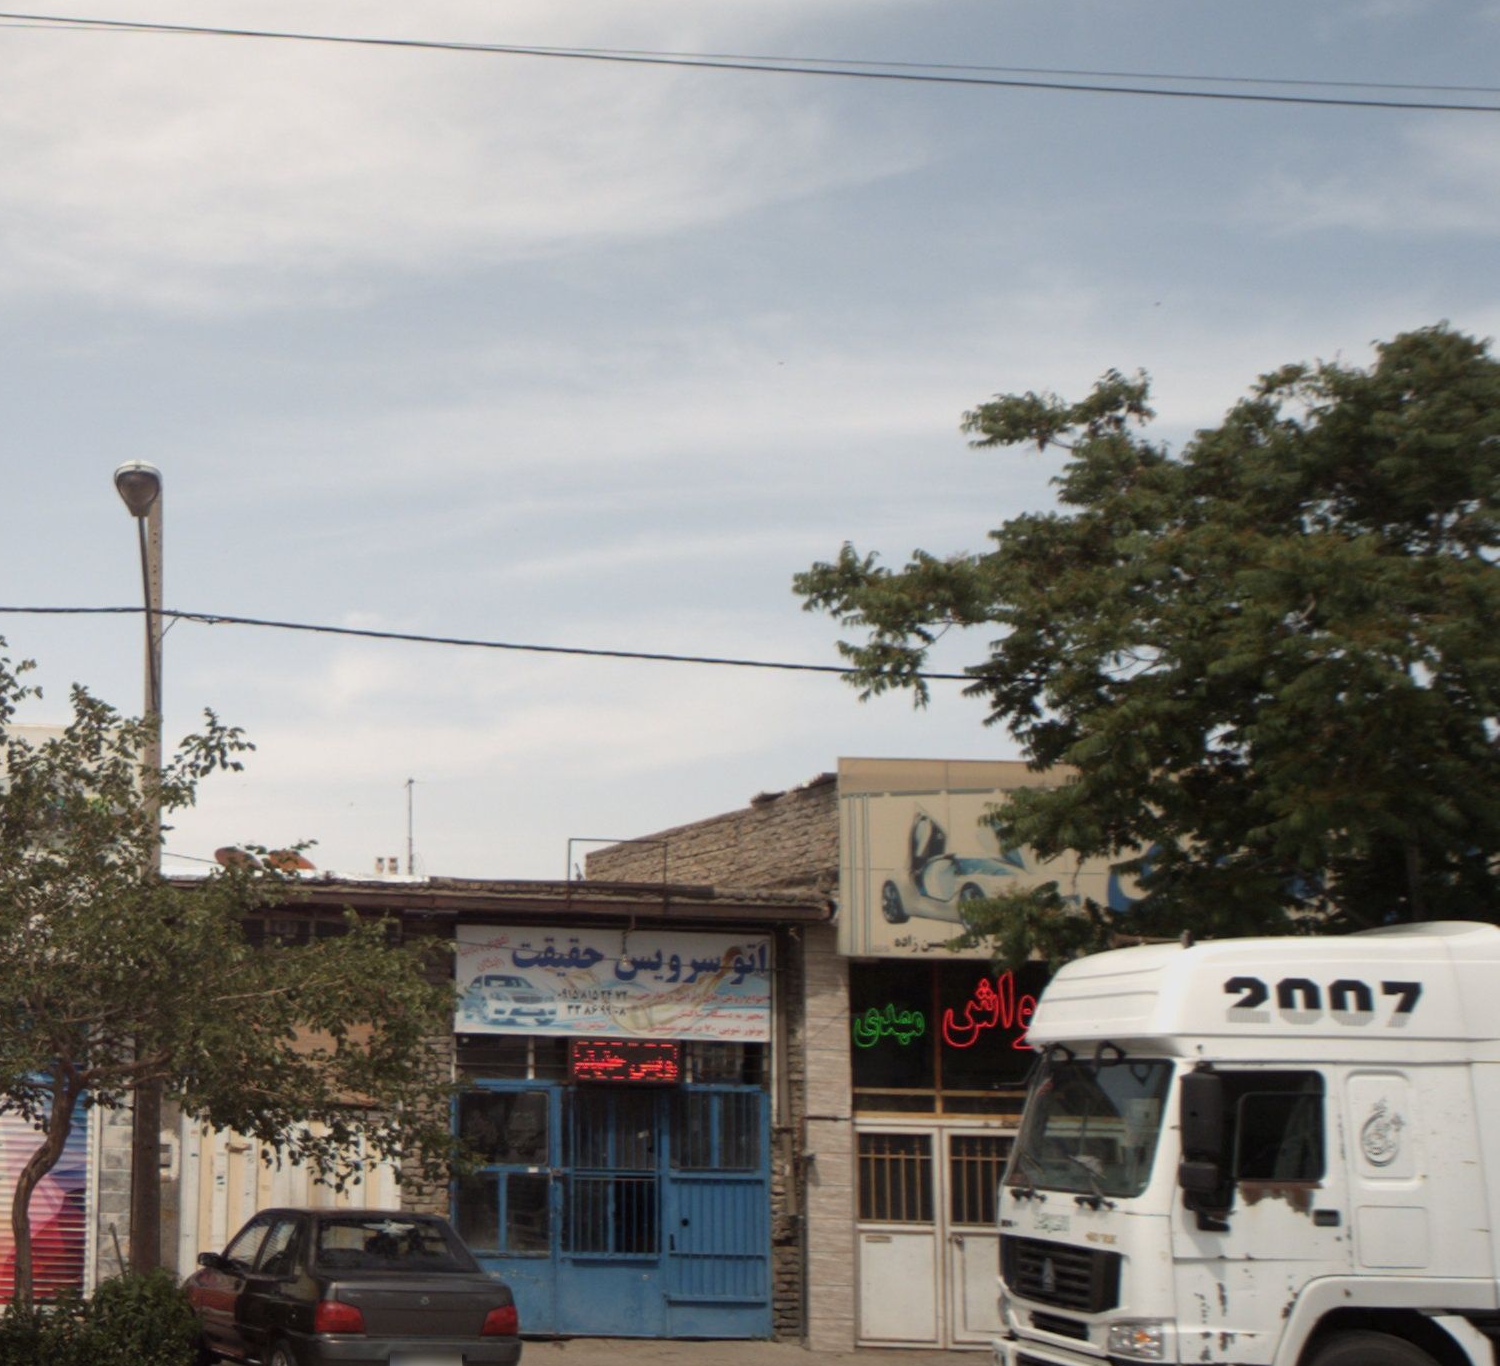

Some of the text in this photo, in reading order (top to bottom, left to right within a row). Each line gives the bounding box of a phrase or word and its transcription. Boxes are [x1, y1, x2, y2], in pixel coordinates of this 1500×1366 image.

[512, 937, 605, 977] حقیقت
[615, 947, 721, 983] سرویس
[730, 943, 767, 985] اتو
[943, 969, 1039, 1050] واش
[1224, 976, 1422, 1028] 2007
[854, 1003, 925, 1048] مهدی
